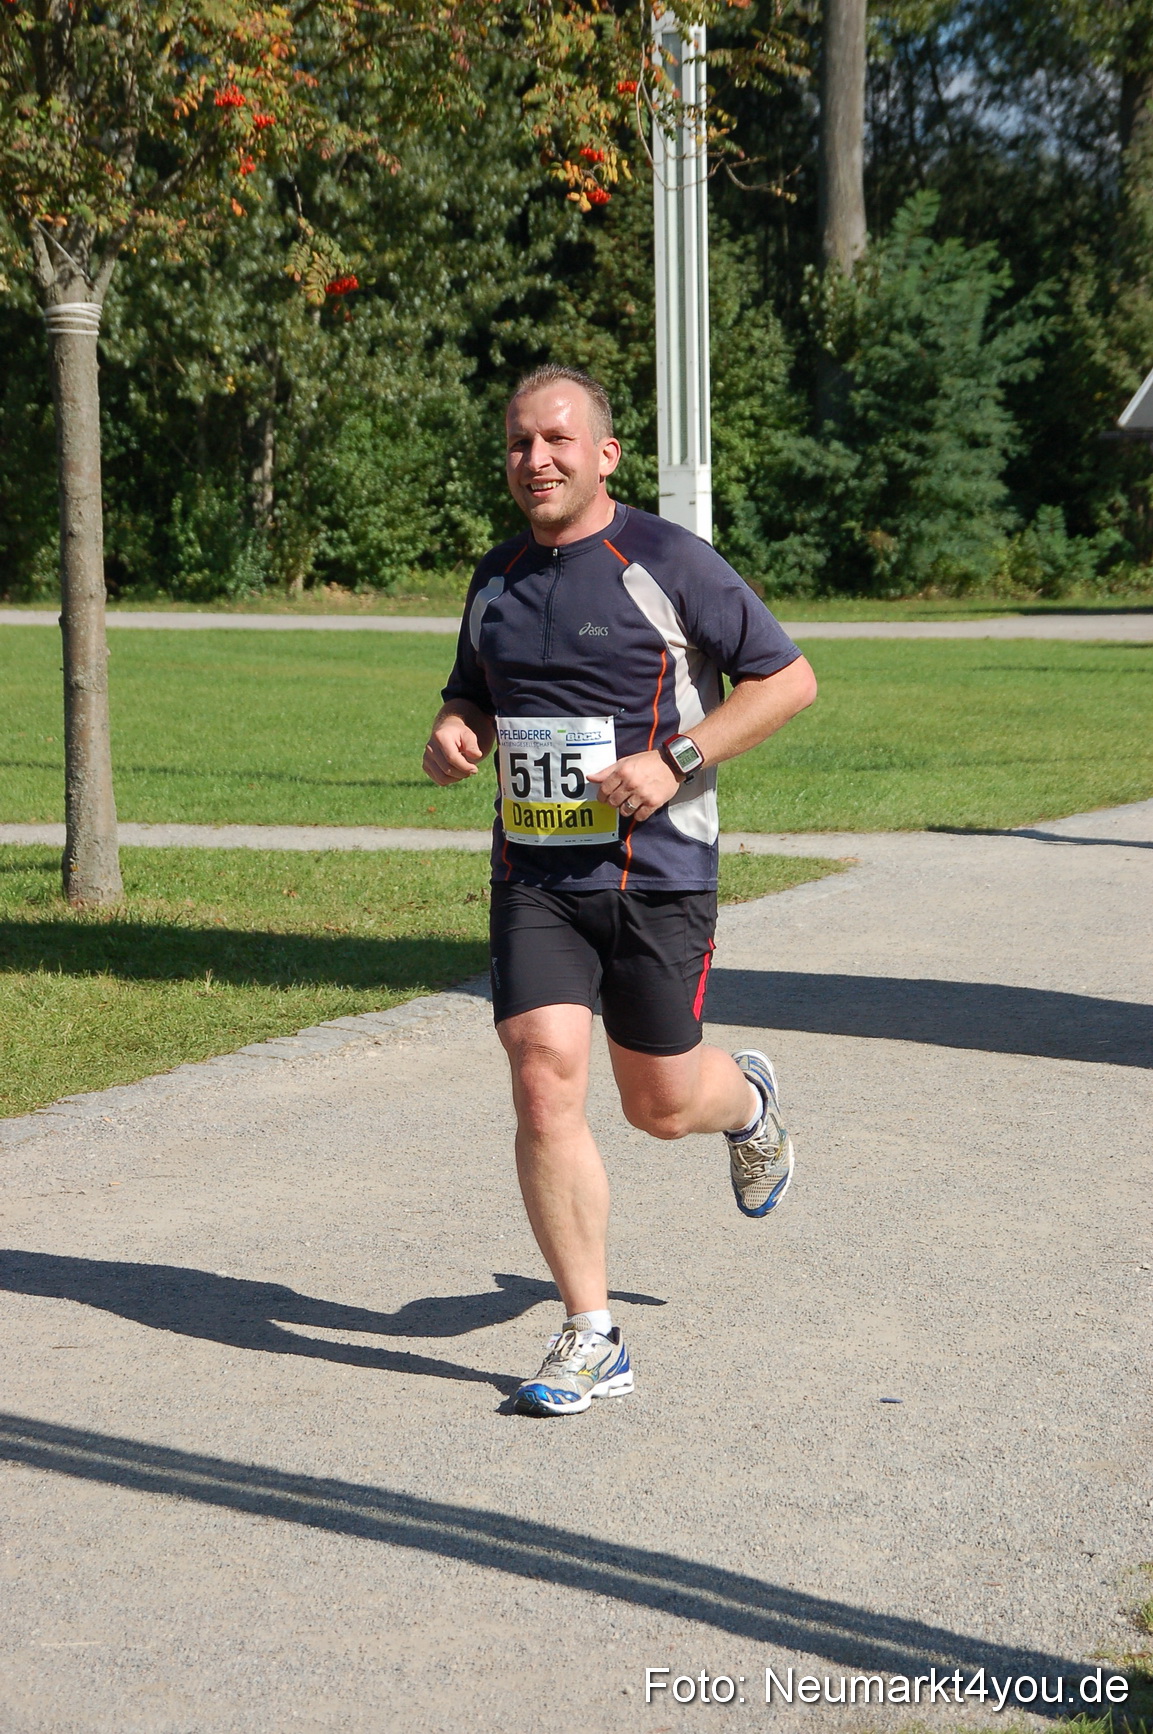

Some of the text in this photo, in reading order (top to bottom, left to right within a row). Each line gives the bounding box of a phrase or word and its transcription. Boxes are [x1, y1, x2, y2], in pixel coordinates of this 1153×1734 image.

[499, 729, 552, 741] PFLEIDERER
[509, 752, 586, 799] 515
[512, 803, 594, 829] Damian
